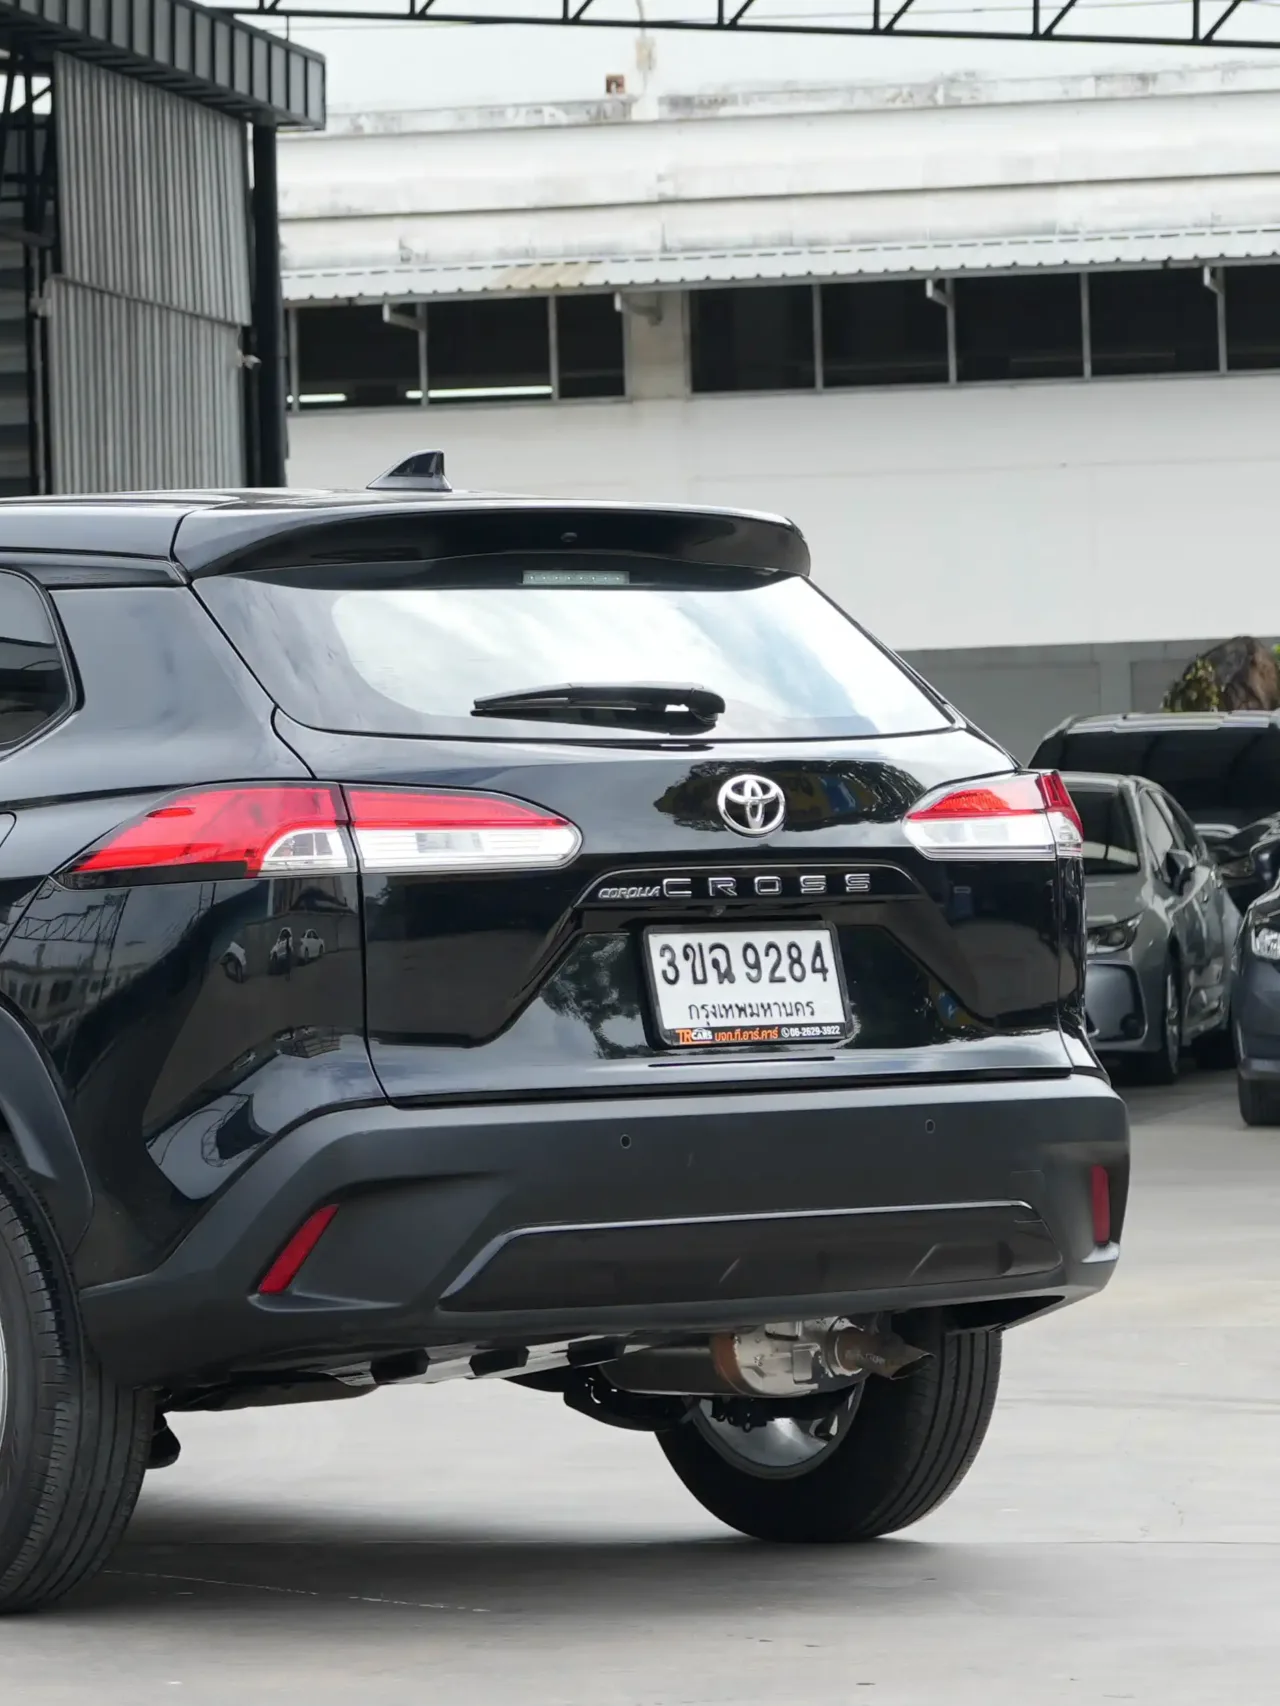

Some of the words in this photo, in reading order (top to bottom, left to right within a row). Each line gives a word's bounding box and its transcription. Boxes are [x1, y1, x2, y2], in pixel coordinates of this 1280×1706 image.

[598, 886, 661, 899] COROLLA
[662, 873, 871, 898] CROSS
[742, 940, 829, 984] 9284
[688, 1001, 815, 1027] กรุงเทพมหานคร
